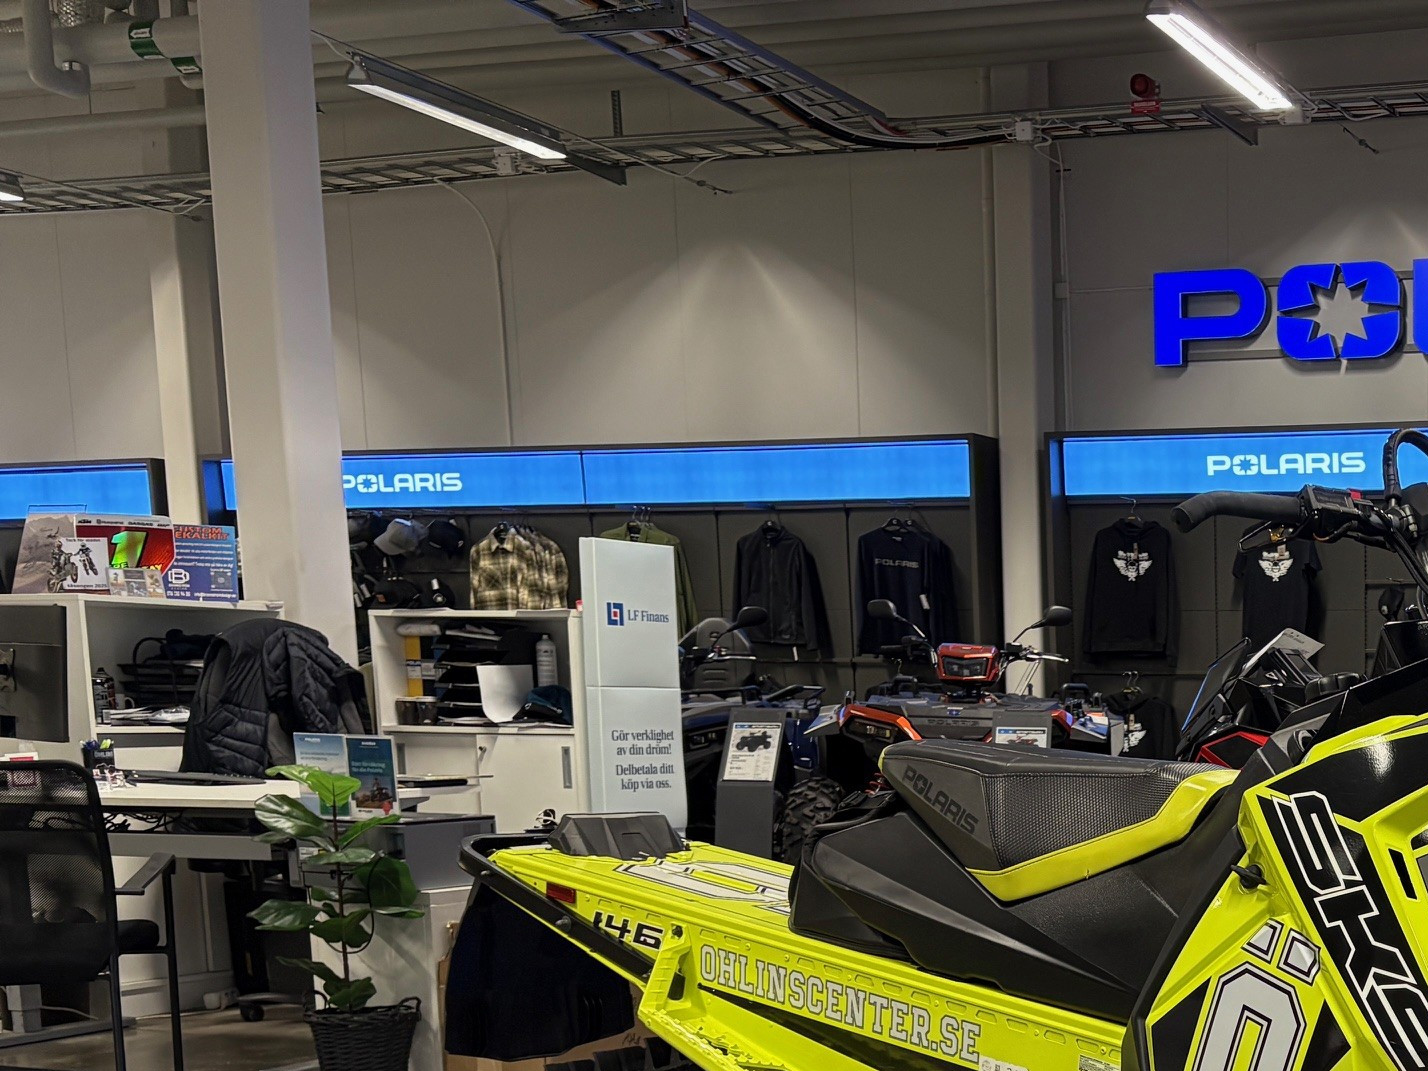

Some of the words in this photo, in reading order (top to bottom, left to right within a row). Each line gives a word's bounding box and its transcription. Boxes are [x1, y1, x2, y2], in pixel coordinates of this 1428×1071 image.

[1207, 452, 1365, 475] POLARIS
[875, 558, 919, 568] POLARIS
[628, 609, 640, 620] LF
[641, 610, 670, 622] Finans
[611, 730, 630, 741] Gör
[631, 729, 674, 743] verklighet
[616, 747, 628, 755] av
[629, 743, 644, 755] din
[645, 743, 672, 755] dröm!
[616, 763, 658, 775] Delbetala
[659, 762, 674, 774] ditt
[621, 778, 640, 792] köp
[640, 778, 654, 789] via
[655, 780, 672, 789] oss.
[903, 765, 979, 834] POLARIS
[700, 944, 981, 1063] OHLINSCENTER.SE
